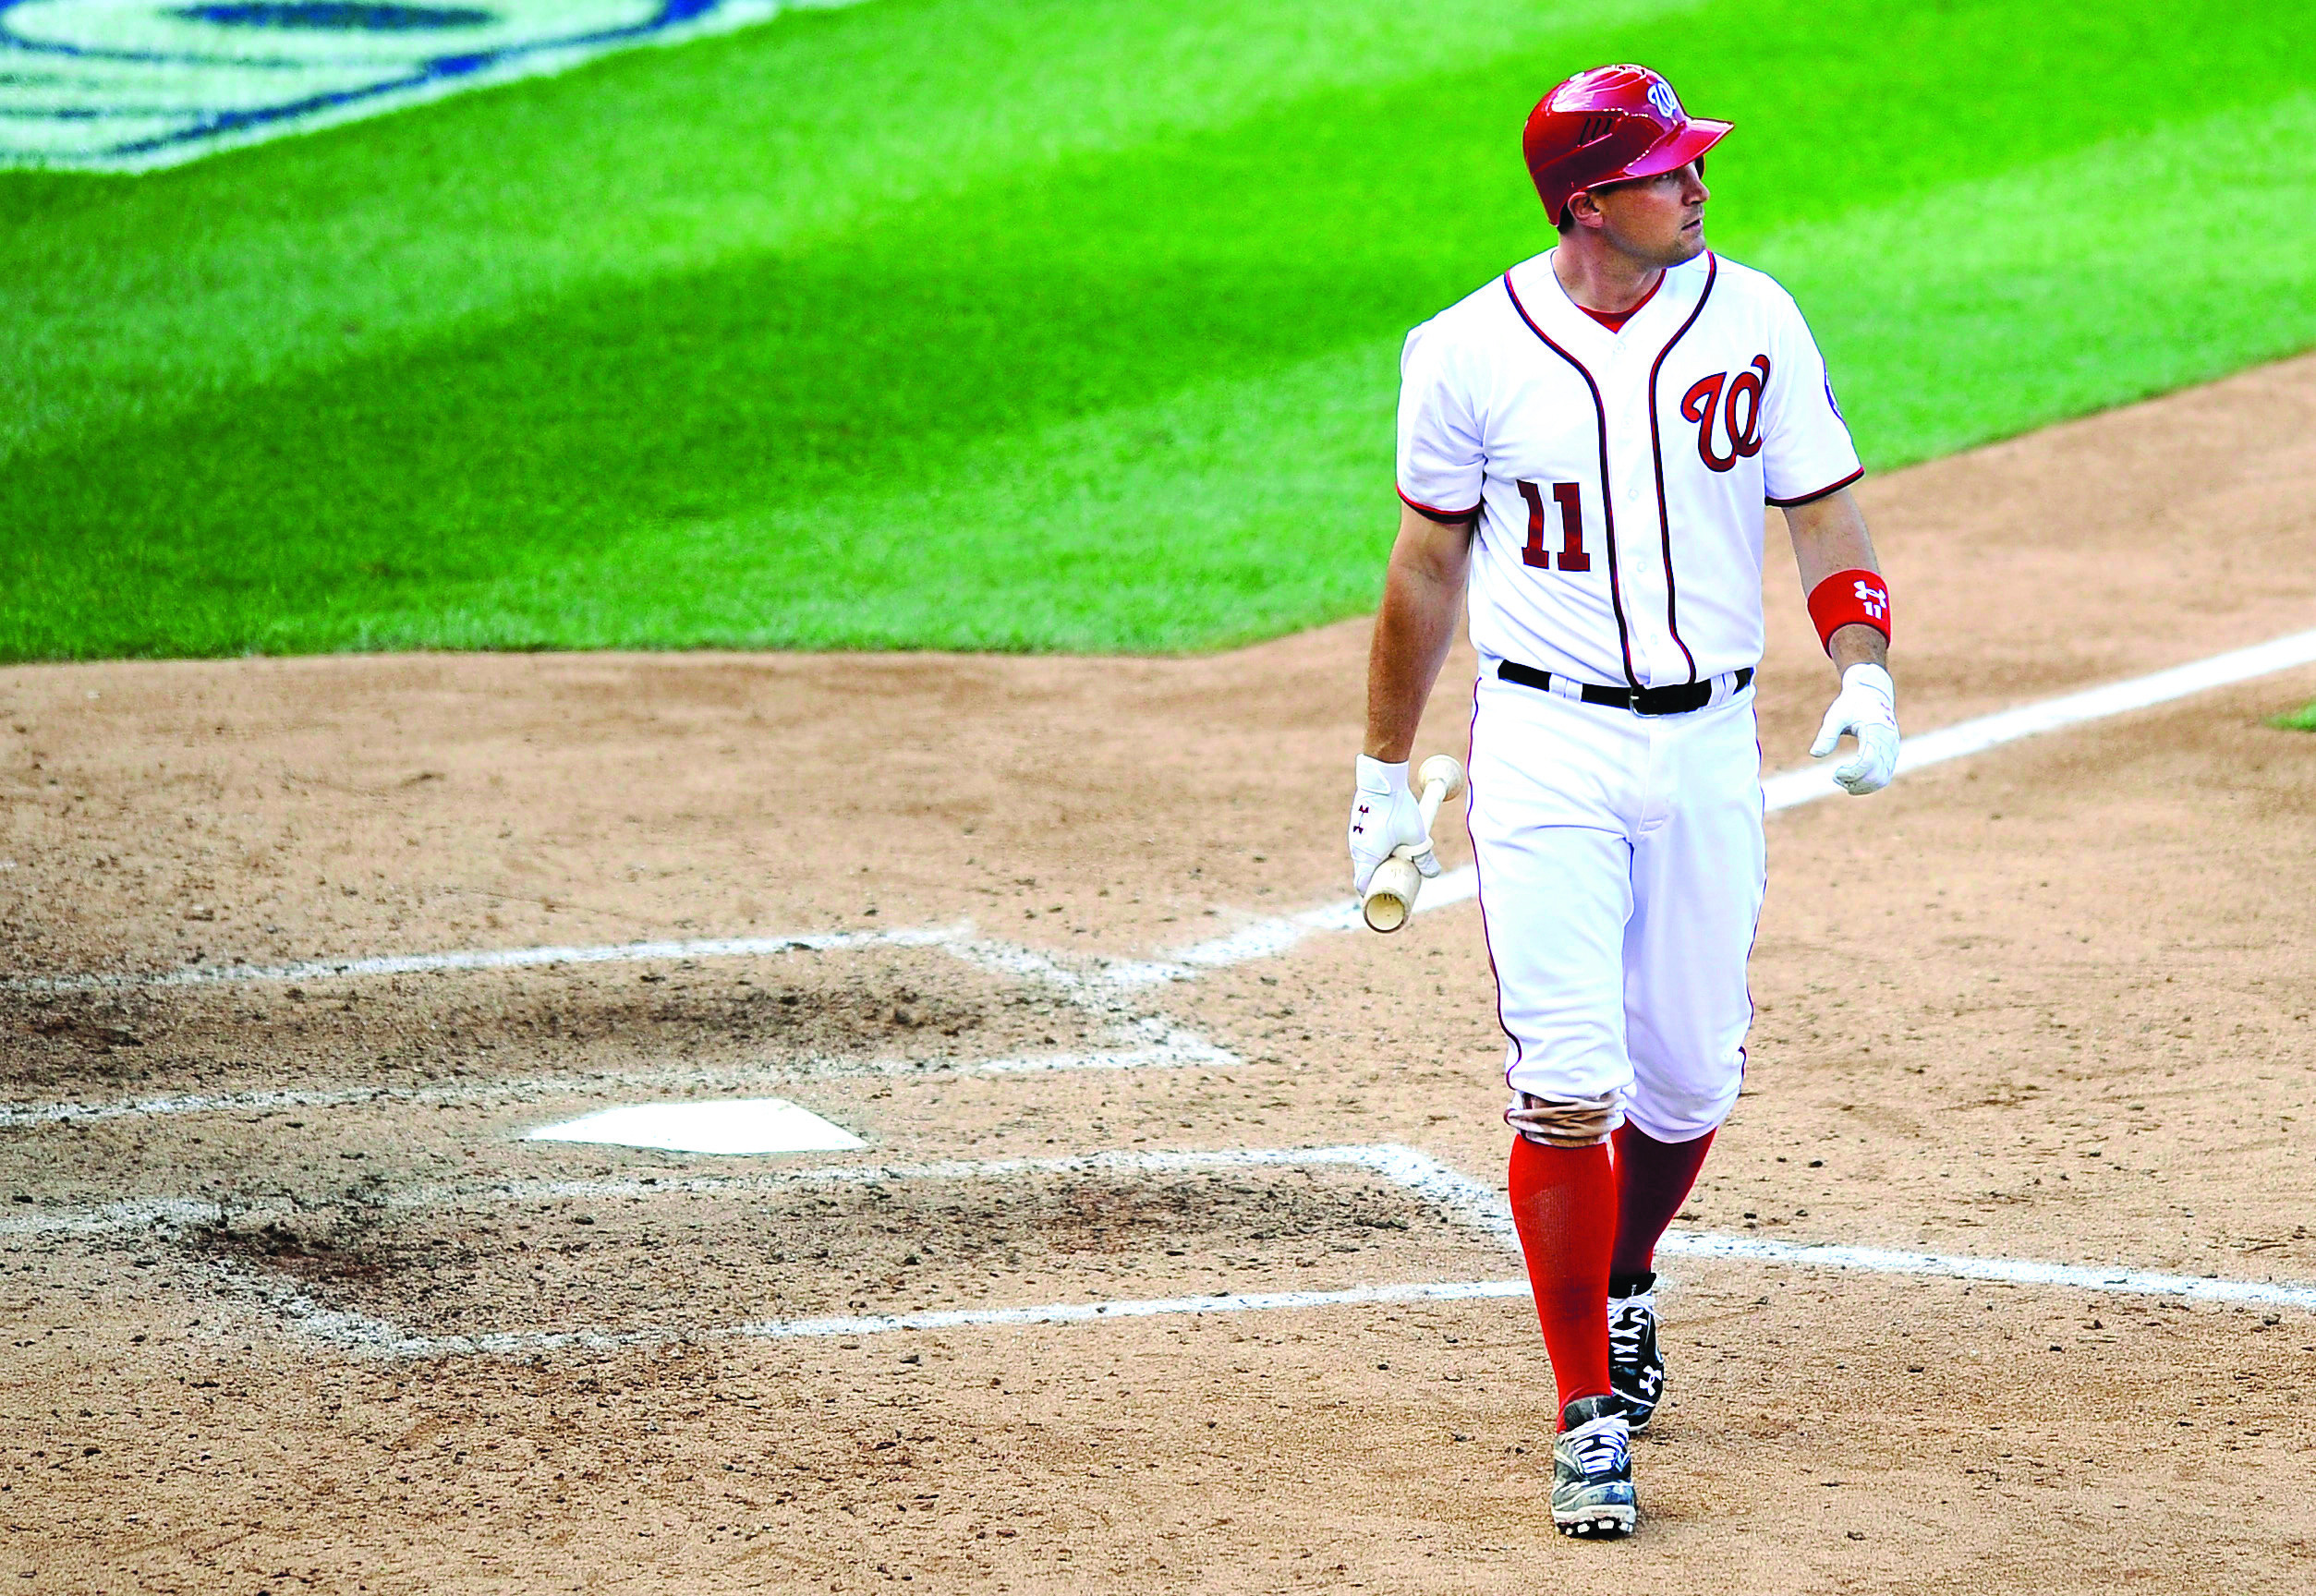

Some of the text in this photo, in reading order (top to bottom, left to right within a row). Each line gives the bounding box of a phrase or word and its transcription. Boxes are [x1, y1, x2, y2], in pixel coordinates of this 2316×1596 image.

[1647, 81, 1678, 117] W
[1680, 354, 1770, 472] W
[1516, 478, 1591, 572] 11
[1863, 600, 1882, 620] 11
